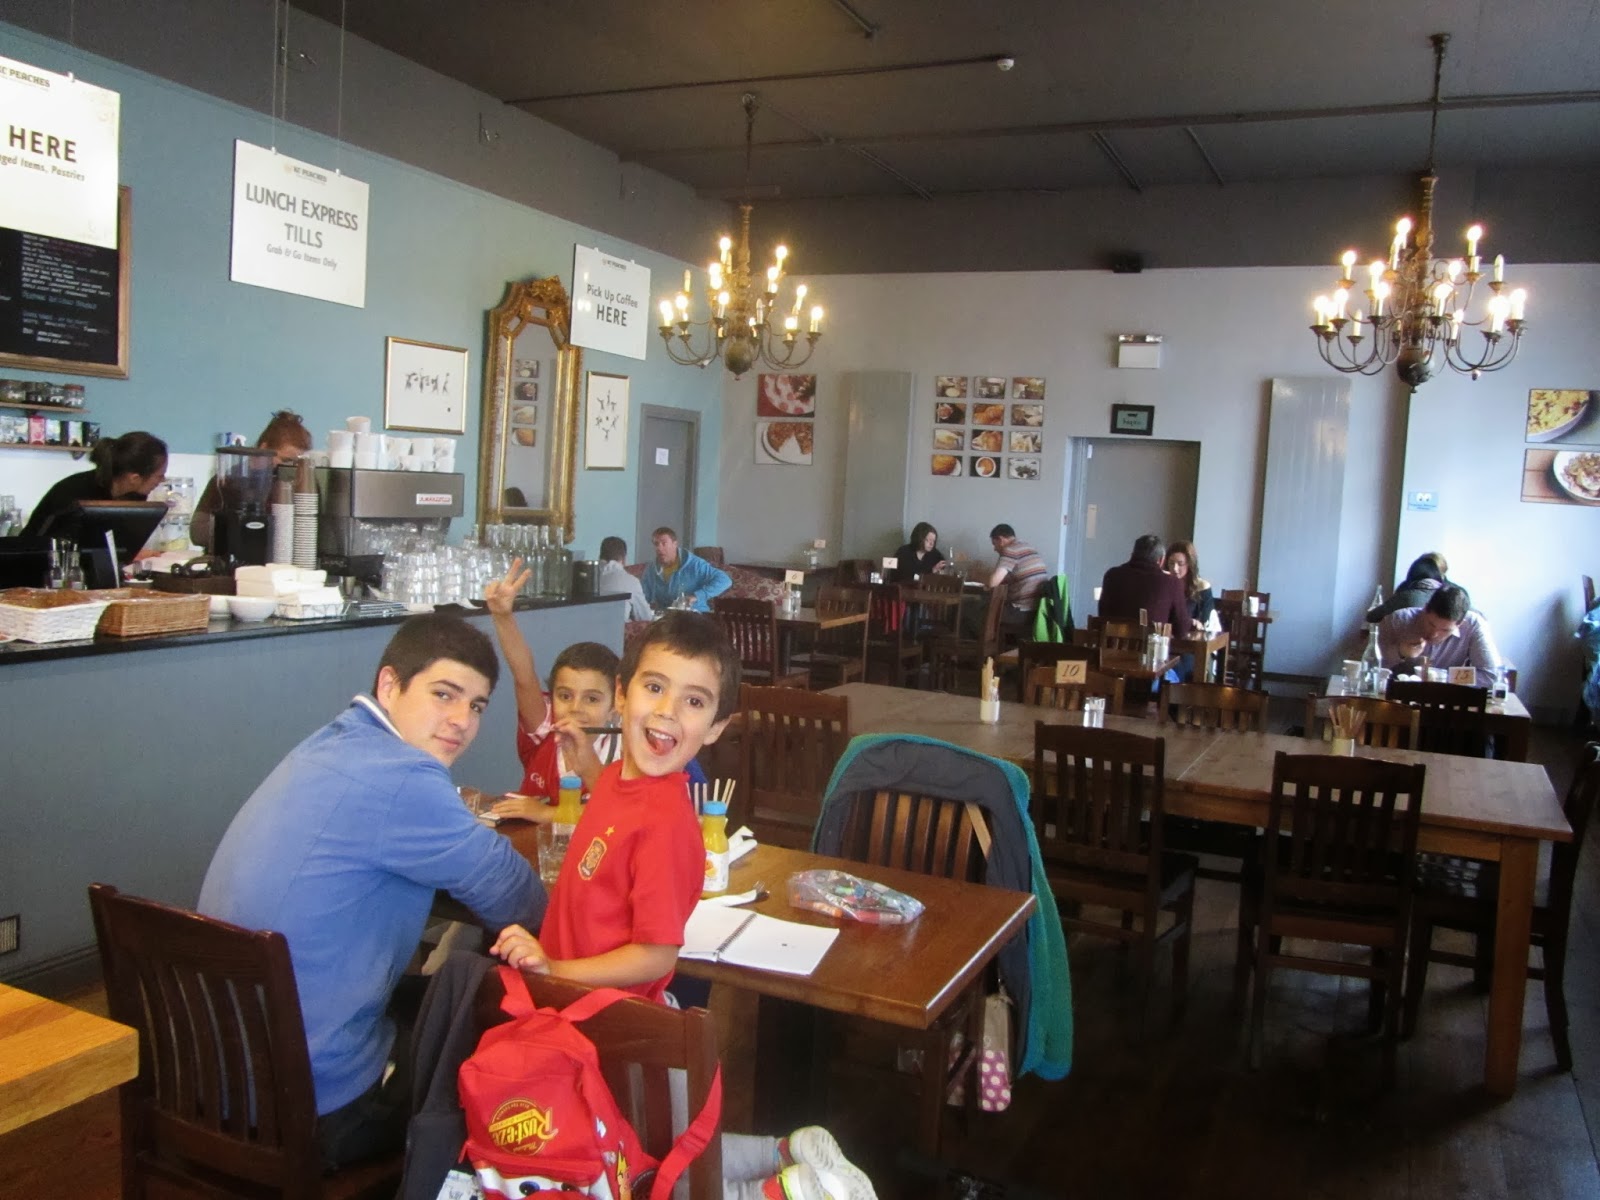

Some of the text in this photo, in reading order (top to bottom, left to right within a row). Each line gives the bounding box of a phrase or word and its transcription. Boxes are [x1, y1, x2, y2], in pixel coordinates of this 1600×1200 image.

[9, 68, 50, 87] PEACHES
[9, 124, 77, 163] HERE
[0, 155, 17, 166] ged
[51, 165, 85, 182] Pastries
[246, 182, 358, 231] LUNCH EXPRESS
[284, 222, 323, 249] TILLS
[266, 243, 283, 256] Grab
[292, 250, 302, 261] Go
[303, 253, 322, 265] Items
[323, 257, 338, 272] Only
[587, 283, 639, 309] Pick Up Coffee
[597, 304, 627, 327] HERE
[1061, 664, 1080, 677] 10
